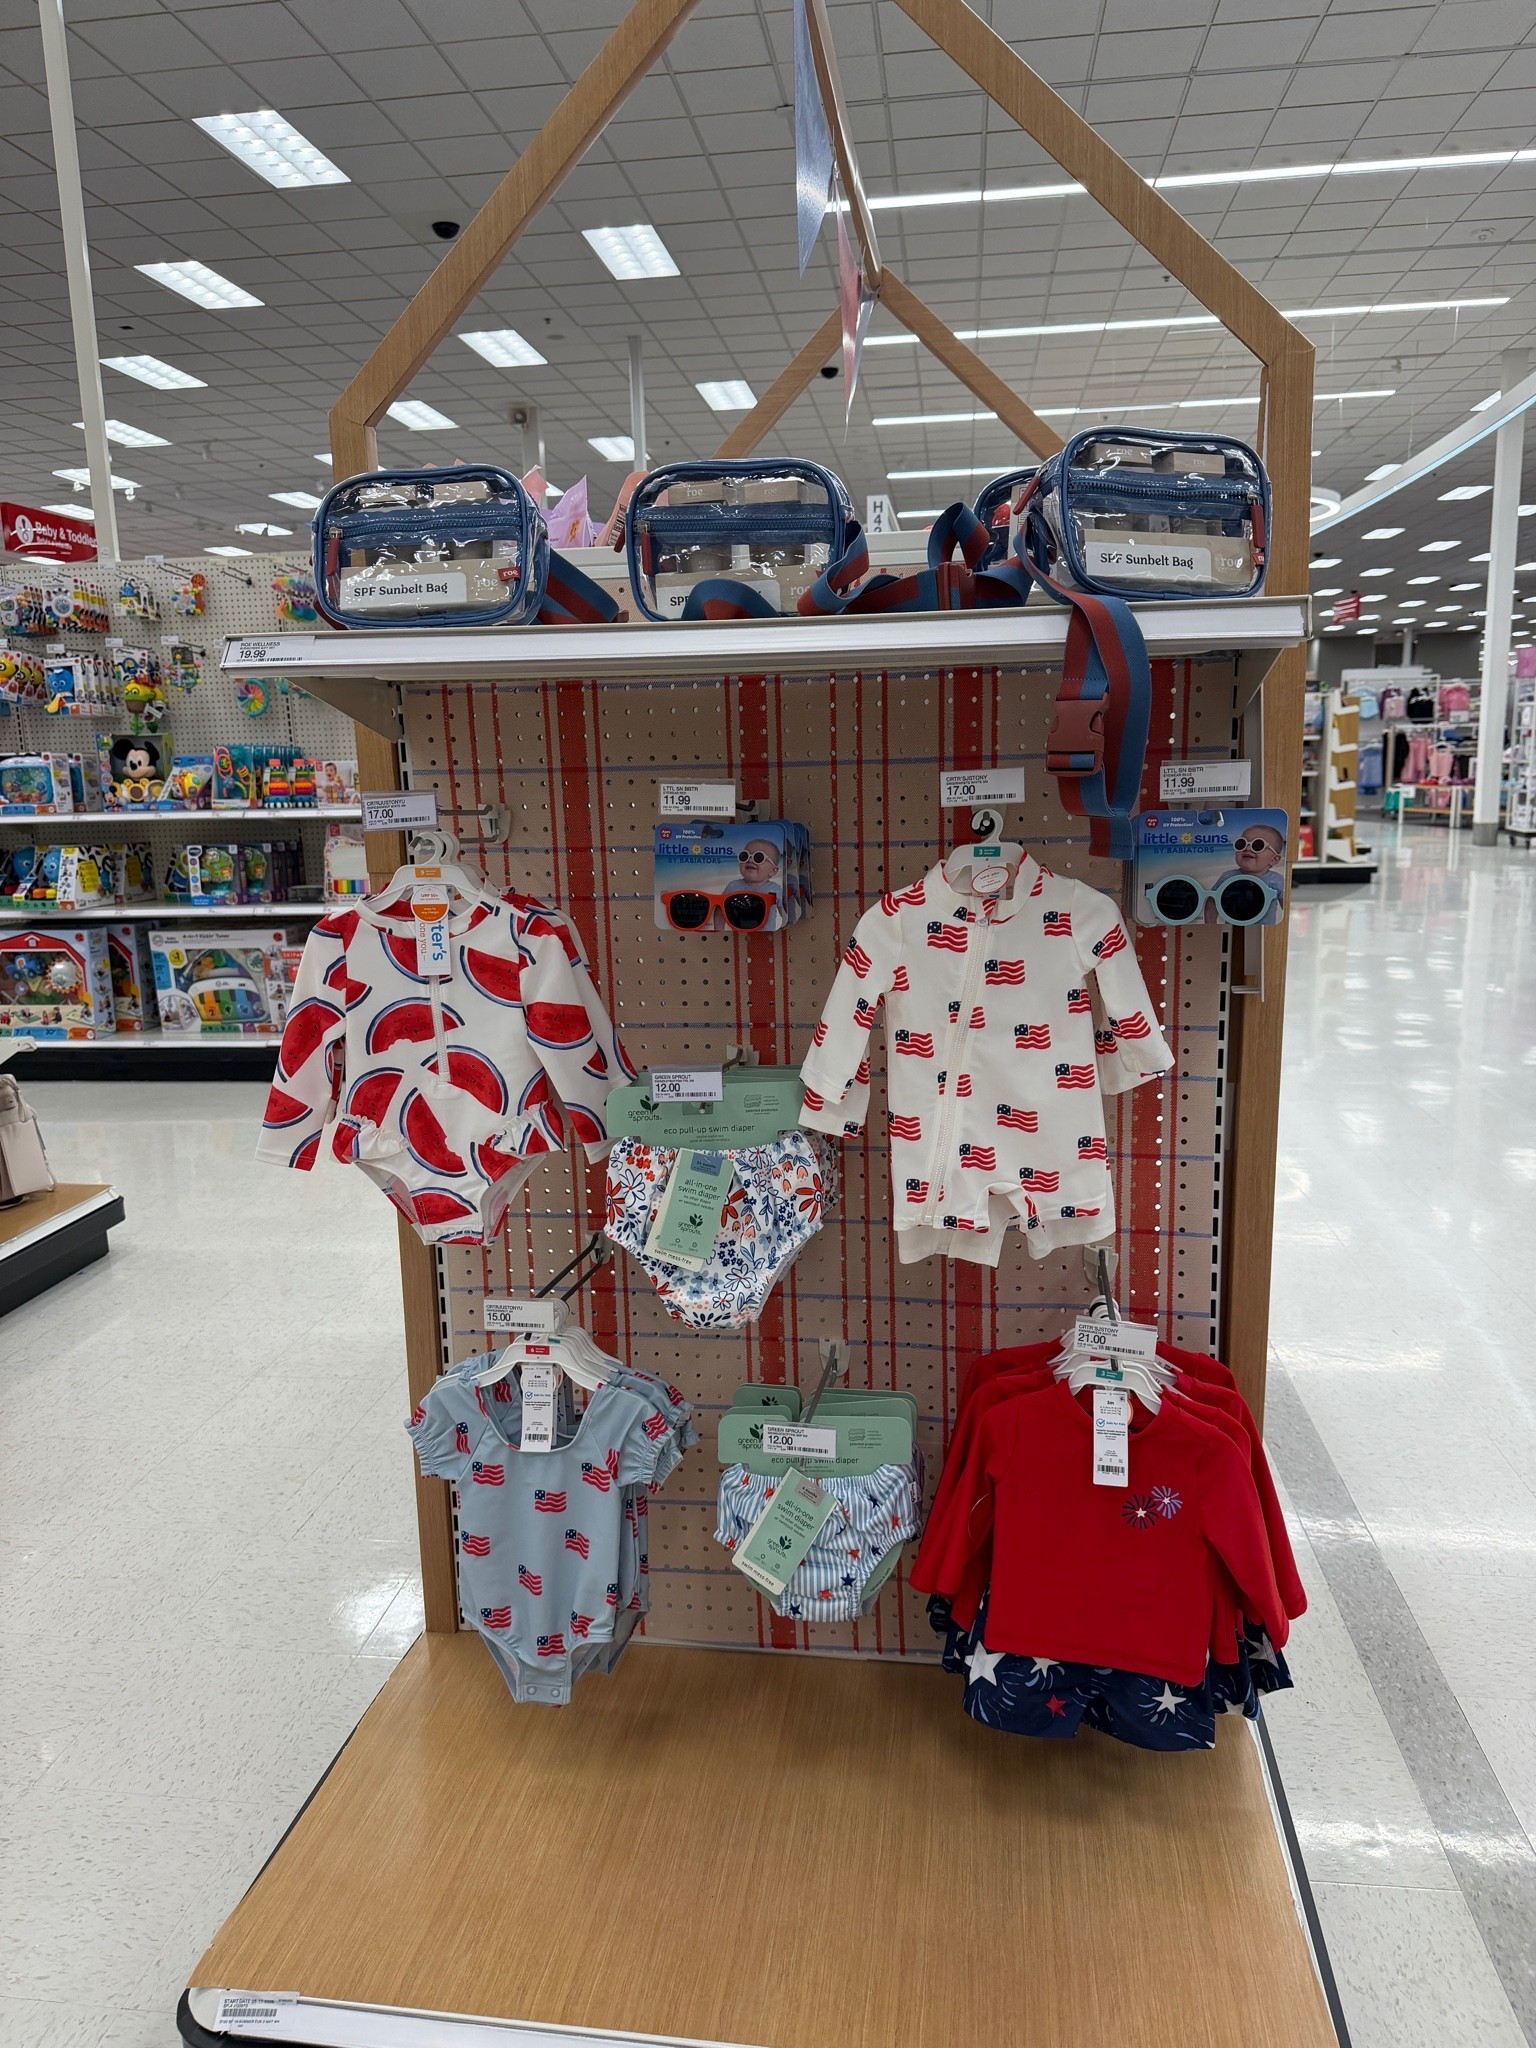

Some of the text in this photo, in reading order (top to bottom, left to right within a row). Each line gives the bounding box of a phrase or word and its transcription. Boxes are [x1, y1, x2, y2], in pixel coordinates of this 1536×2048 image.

[686, 488, 704, 497] roe
[59, 527, 67, 540] &
[1100, 552, 1194, 570] SPF Sunbelt Bag
[502, 569, 519, 577] roe
[476, 577, 499, 588] roe
[353, 582, 449, 597] SPF Sunbelt Bag
[239, 649, 267, 659] 19.99
[1164, 777, 1195, 788] 11.99
[946, 784, 976, 796] 17.00
[663, 795, 691, 805] 11.99
[368, 808, 394, 819] 17.00
[1143, 832, 1178, 845] little
[658, 843, 689, 855] little
[1166, 846, 1215, 854] BABIATORS
[418, 938, 427, 954] you
[655, 1082, 681, 1093] 12.00
[627, 1109, 650, 1119] green
[663, 1124, 756, 1137] eco pull-up swim diaper
[684, 1178, 718, 1193] all-in-one
[677, 1185, 721, 1201] swim diaper
[677, 1221, 694, 1229] green
[654, 1248, 693, 1266] swim mess-free
[487, 1312, 511, 1322] 15.00
[1077, 1332, 1107, 1345] 21.00
[737, 1438, 758, 1446] green
[768, 1435, 794, 1446] 12.00
[741, 1443, 763, 1451] sprou
[835, 1457, 859, 1467] diaper
[784, 1499, 814, 1522] all-in-one
[777, 1503, 815, 1531] swim diaper
[767, 1538, 782, 1549] green
[741, 1560, 754, 1572] swim
[753, 1567, 775, 1587] mess-free
